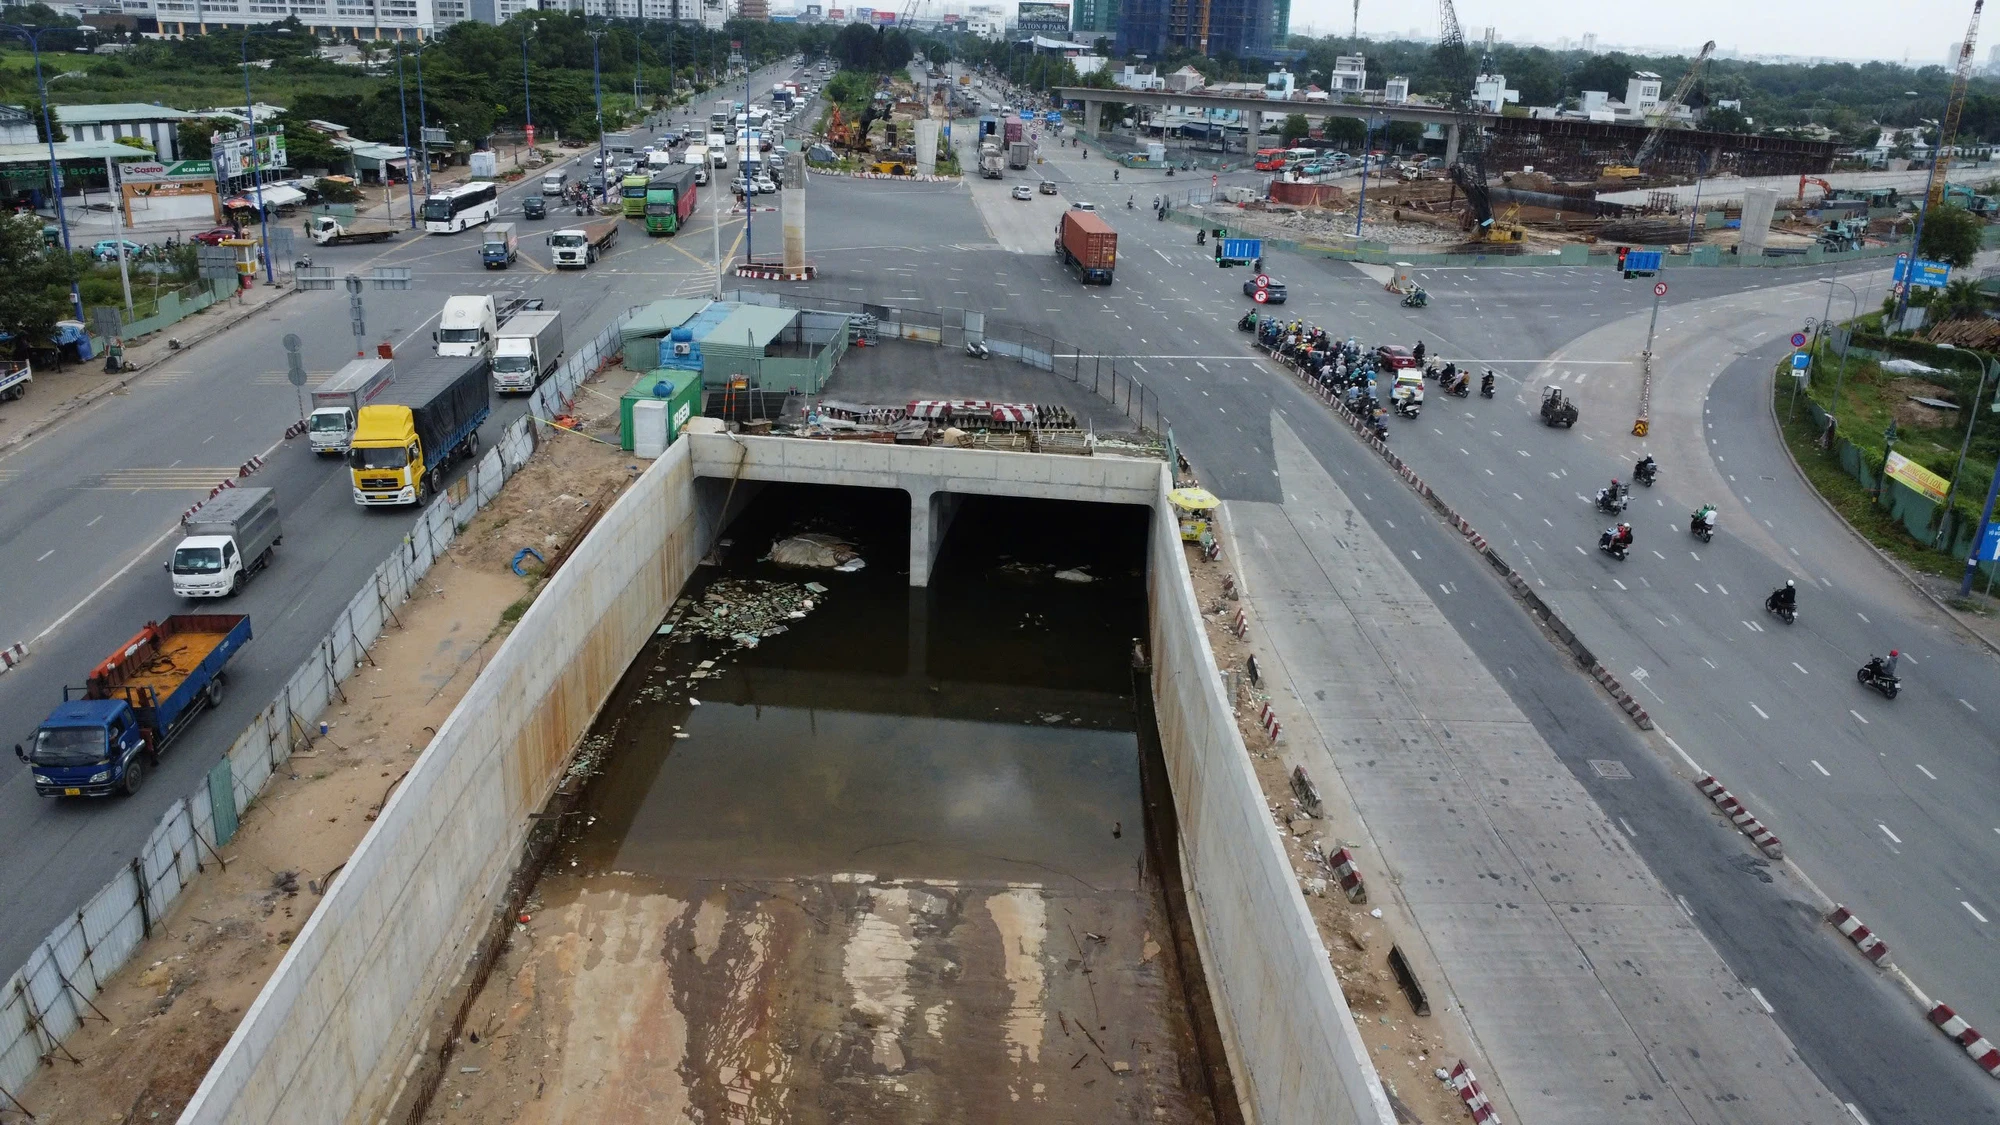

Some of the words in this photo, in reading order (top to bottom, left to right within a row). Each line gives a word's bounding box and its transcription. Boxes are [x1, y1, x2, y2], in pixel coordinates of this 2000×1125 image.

[1018, 22, 1041, 30] EATON
[1049, 23, 1066, 31] PARK
[70, 167, 106, 176] BCAR
[134, 166, 163, 174] Castrol
